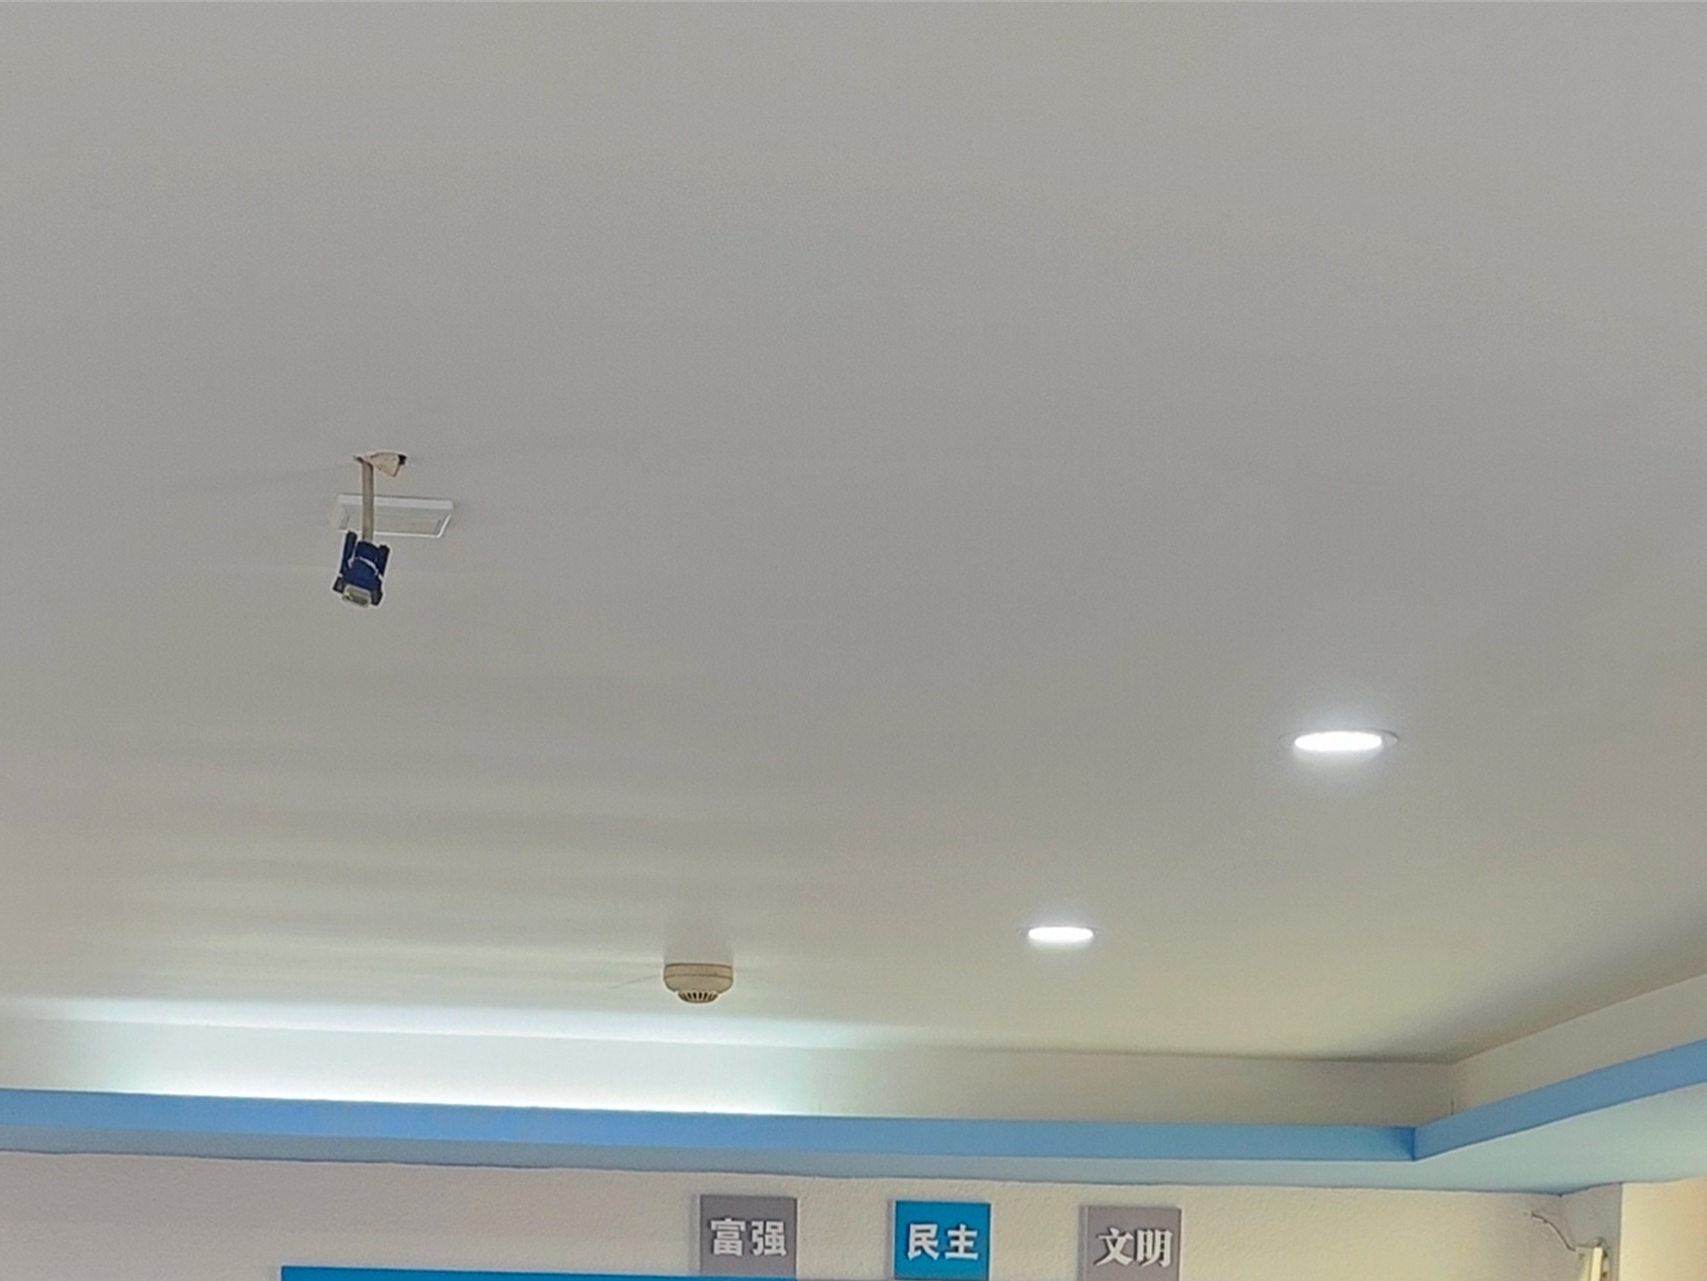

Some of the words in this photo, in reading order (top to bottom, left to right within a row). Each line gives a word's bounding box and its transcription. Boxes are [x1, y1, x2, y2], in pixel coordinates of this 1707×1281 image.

[708, 1217, 788, 1258] 富强
[906, 1220, 979, 1262] 民主
[1097, 1225, 1173, 1269] 文明
